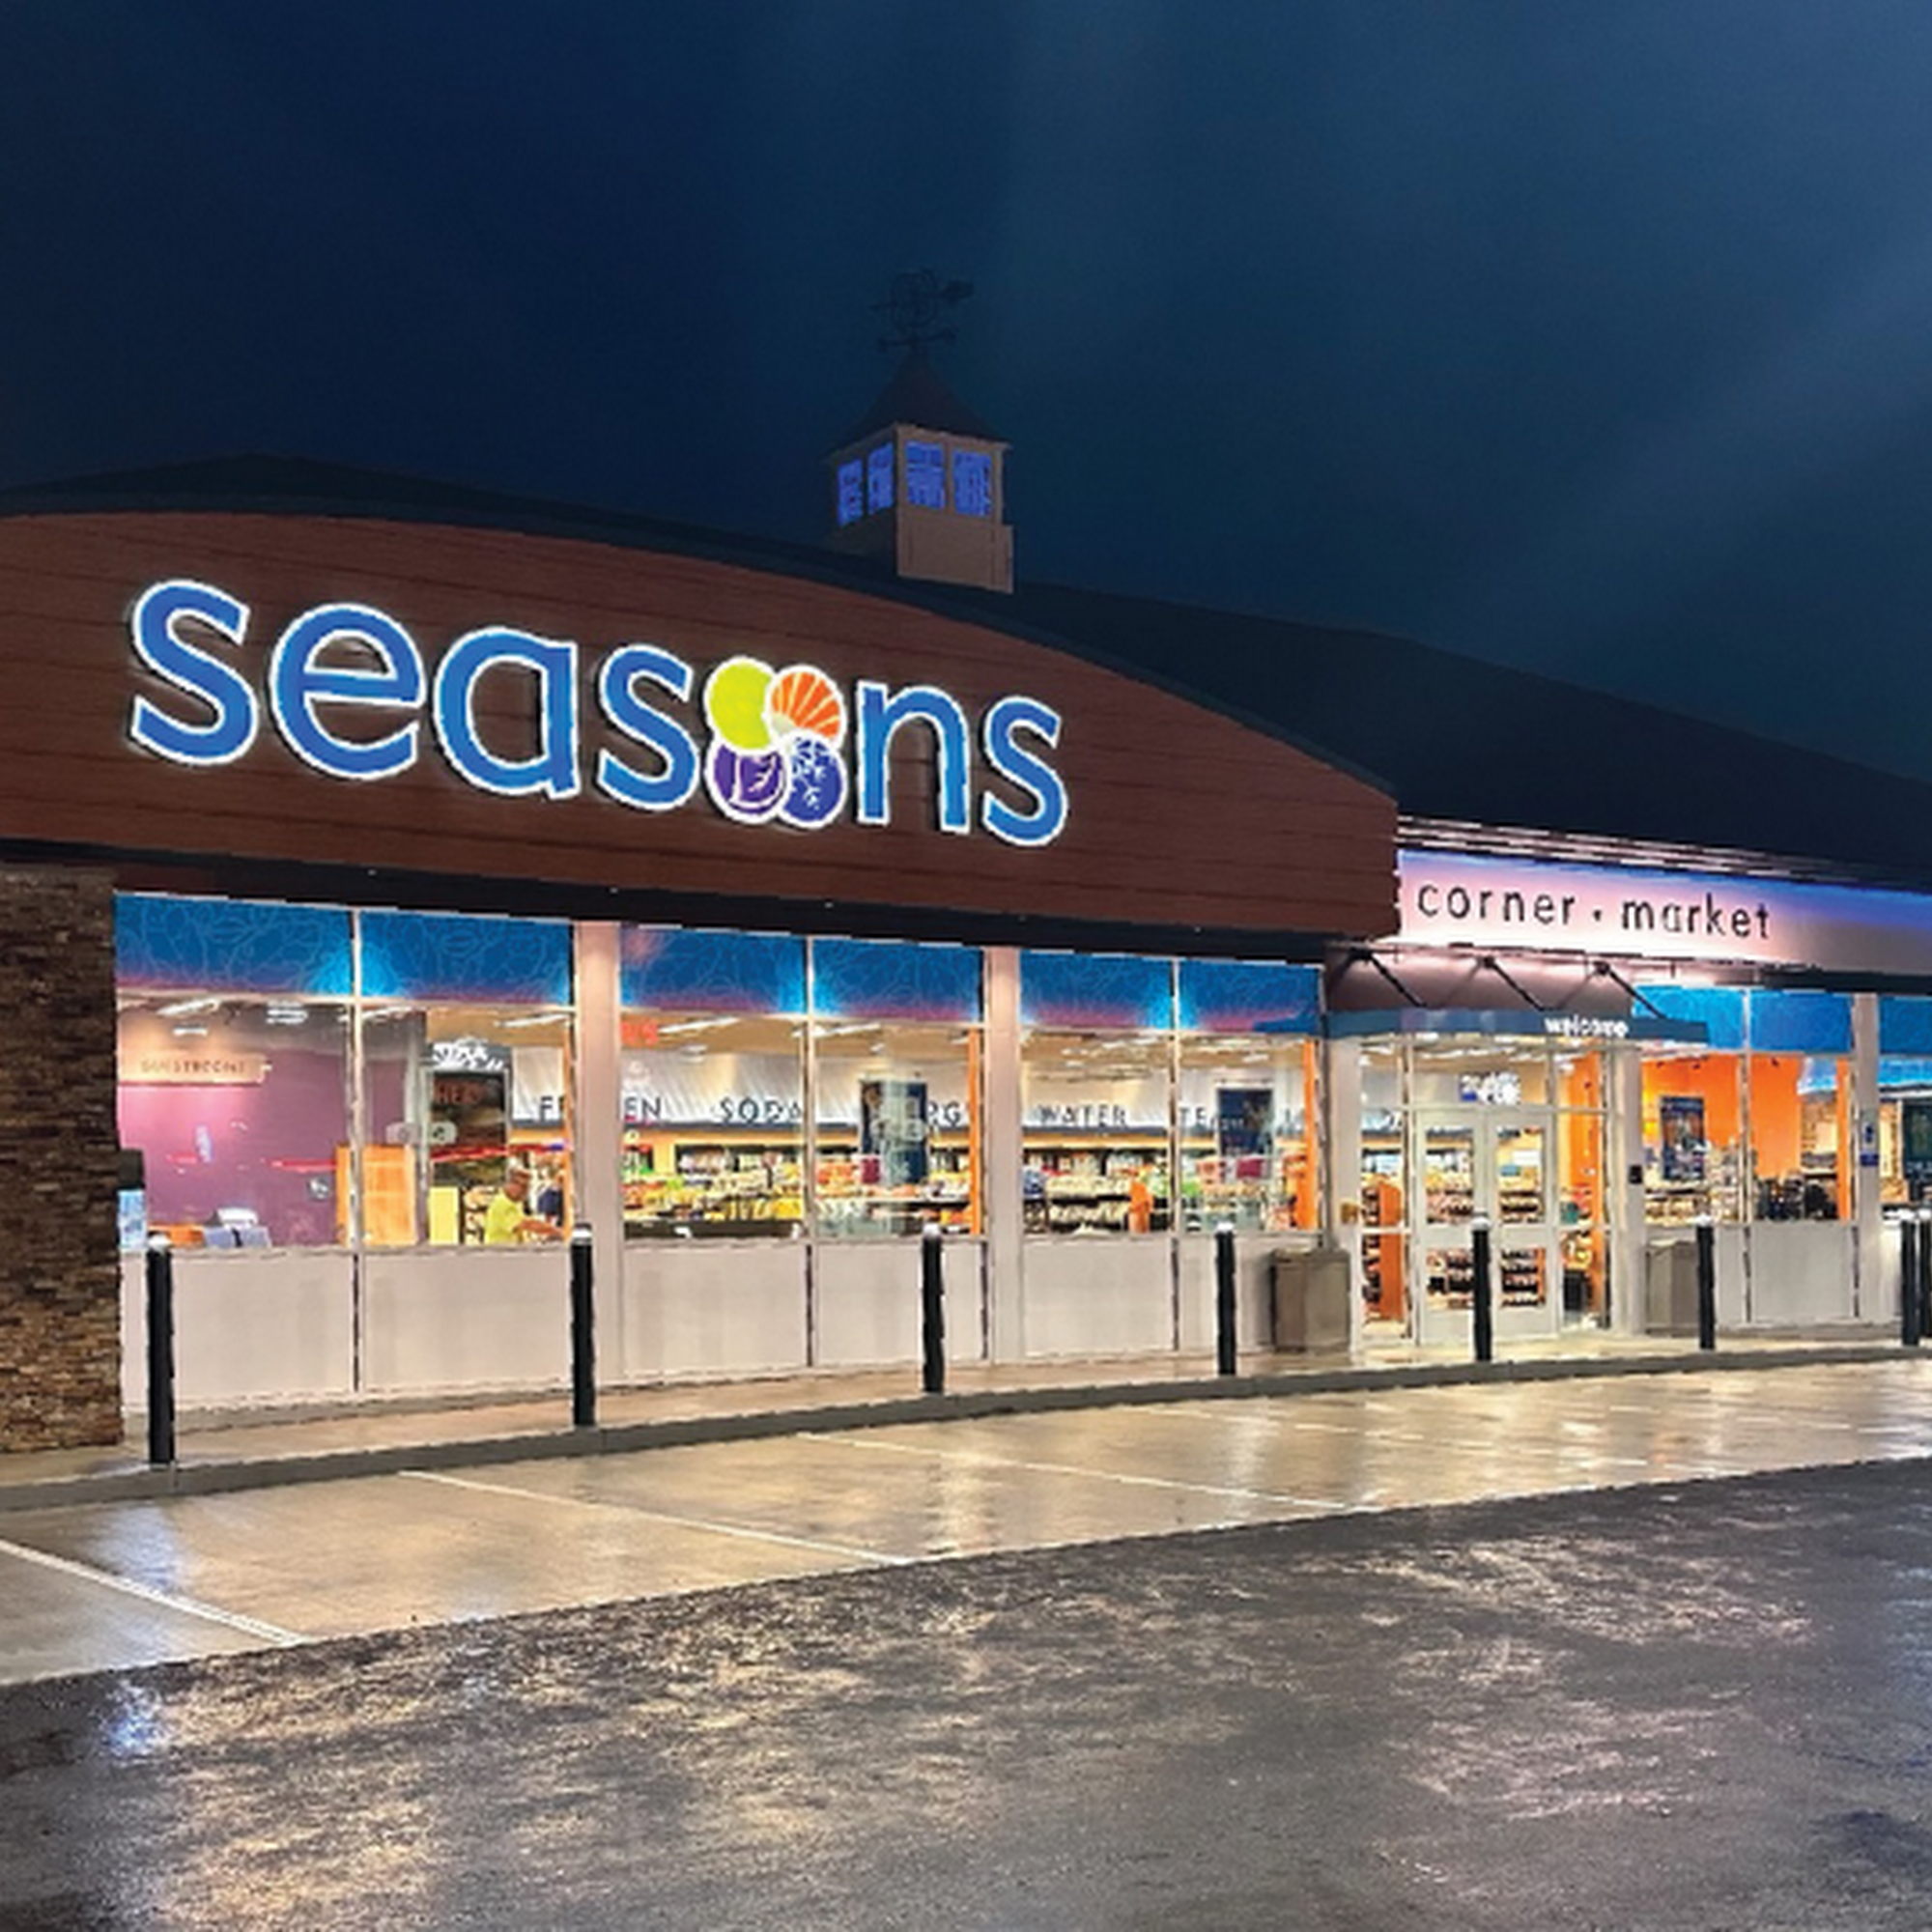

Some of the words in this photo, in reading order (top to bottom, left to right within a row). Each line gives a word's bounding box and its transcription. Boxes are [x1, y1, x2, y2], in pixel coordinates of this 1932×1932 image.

[128, 578, 1068, 846] seasons
[1417, 884, 1575, 925] corner
[1621, 892, 1770, 939] market
[1544, 1013, 1630, 1037] welcome
[719, 1095, 803, 1124] SODA
[1036, 1104, 1128, 1127] WATER
